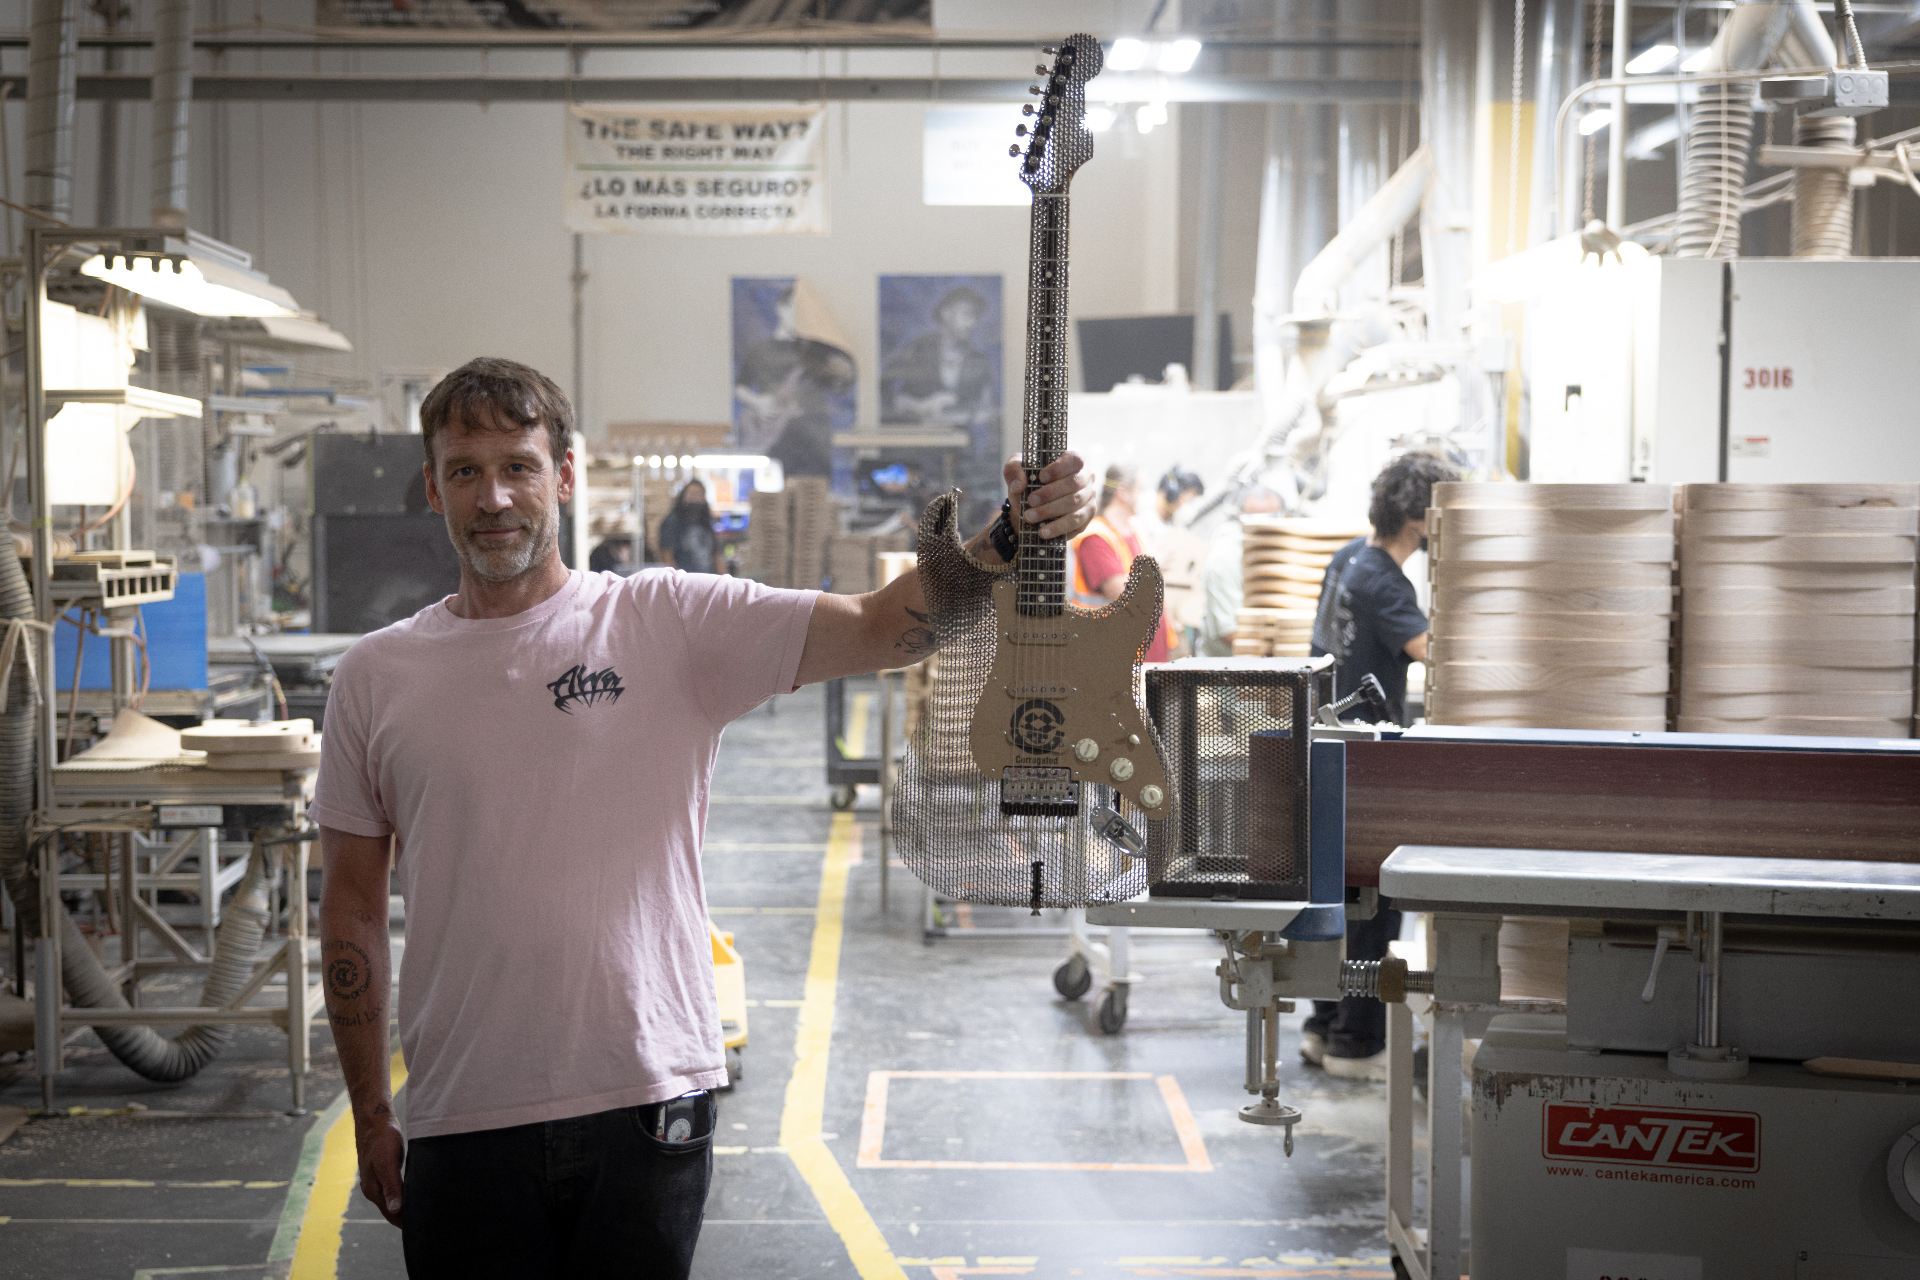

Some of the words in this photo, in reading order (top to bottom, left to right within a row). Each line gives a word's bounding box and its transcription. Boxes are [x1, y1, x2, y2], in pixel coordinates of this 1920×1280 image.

[648, 119, 722, 140] SAFE
[732, 118, 811, 140] WAY?
[616, 145, 655, 160] THE
[661, 145, 726, 160] RIGHT
[731, 145, 776, 160] WAY
[580, 178, 627, 200] ¿LO
[633, 176, 687, 197] MÁS
[694, 178, 812, 197] SEGURO?
[594, 203, 619, 219] LA
[624, 203, 690, 219] FORMA
[695, 203, 797, 220] CORRECTA
[1744, 367, 1793, 389] 3016
[1016, 755, 1058, 765] Corrugated
[1559, 1117, 1755, 1162] CANTEK
